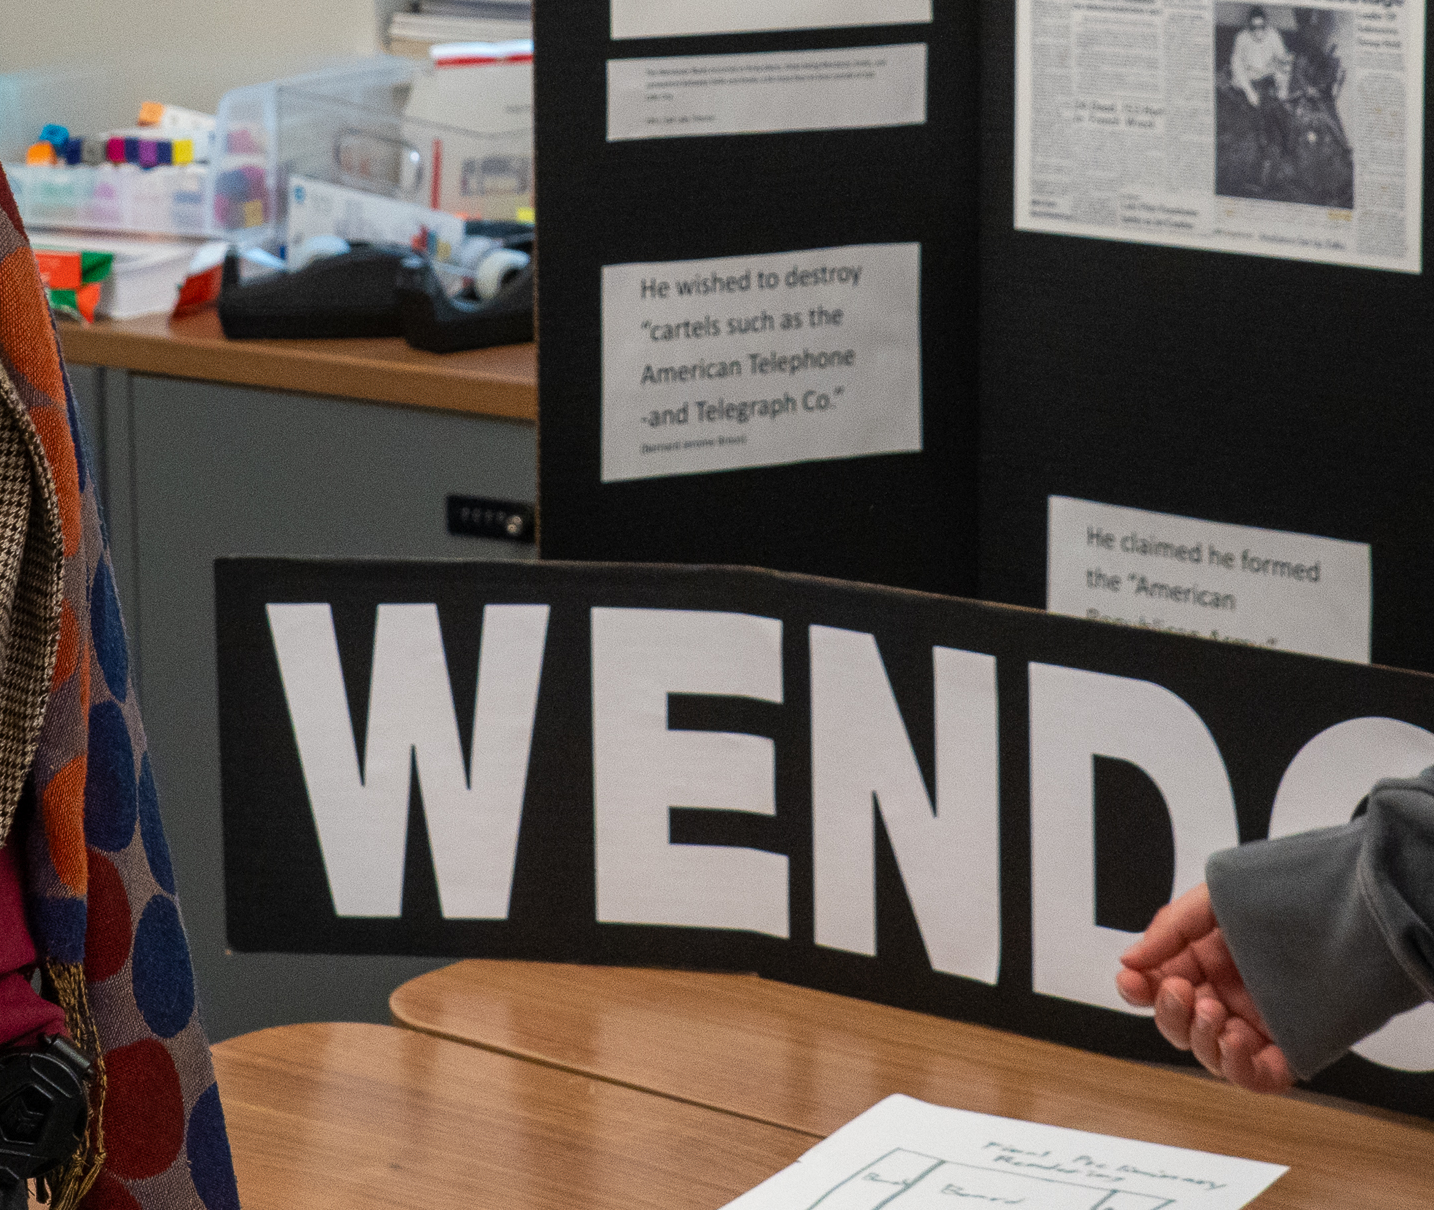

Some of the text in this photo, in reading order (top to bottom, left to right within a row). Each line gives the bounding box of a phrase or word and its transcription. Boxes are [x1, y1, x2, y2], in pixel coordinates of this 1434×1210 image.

[641, 265, 863, 299] He wished to destroy
[726, 310, 775, 336] such
[779, 312, 804, 332] as
[807, 305, 844, 329] the
[641, 349, 857, 385] American Telephone
[695, 394, 797, 423] Telegraph
[1087, 527, 1321, 583] He claimed he formed
[1086, 569, 1122, 592] the
